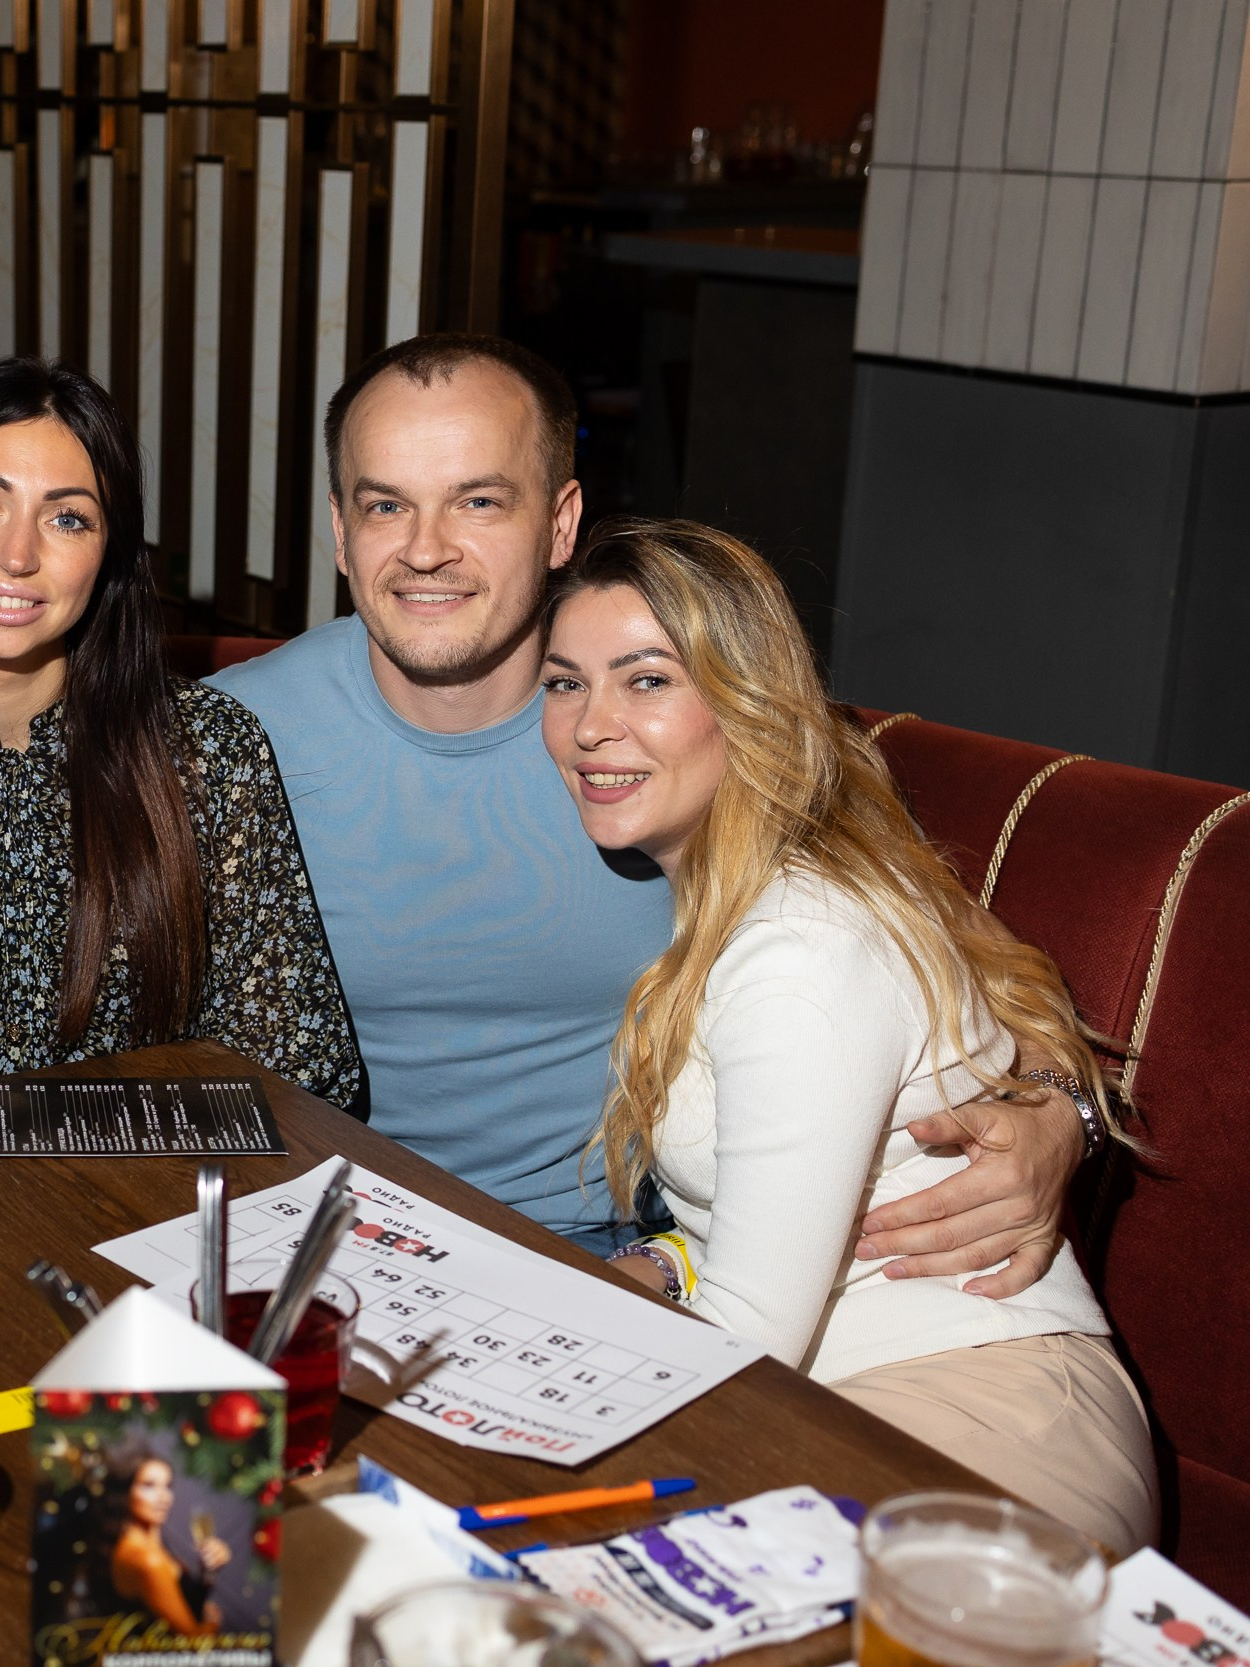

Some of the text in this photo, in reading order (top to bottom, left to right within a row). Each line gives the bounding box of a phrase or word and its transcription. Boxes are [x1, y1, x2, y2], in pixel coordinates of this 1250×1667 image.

[372, 1187, 416, 1210] РАДИО
[271, 1203, 302, 1216] 85
[382, 1217, 432, 1239] РАДИО
[352, 1240, 370, 1250] FM
[373, 1269, 402, 1283] 64
[415, 1285, 446, 1299] 52
[386, 1302, 418, 1316] 56
[397, 1334, 431, 1350] 48
[473, 1335, 507, 1351] 30
[547, 1335, 583, 1351] 28
[447, 1352, 478, 1368] 34
[517, 1351, 551, 1367] 23
[573, 1371, 598, 1384] 11
[653, 1371, 672, 1380] 6
[539, 1387, 569, 1403] 18
[596, 1405, 617, 1416] 3
